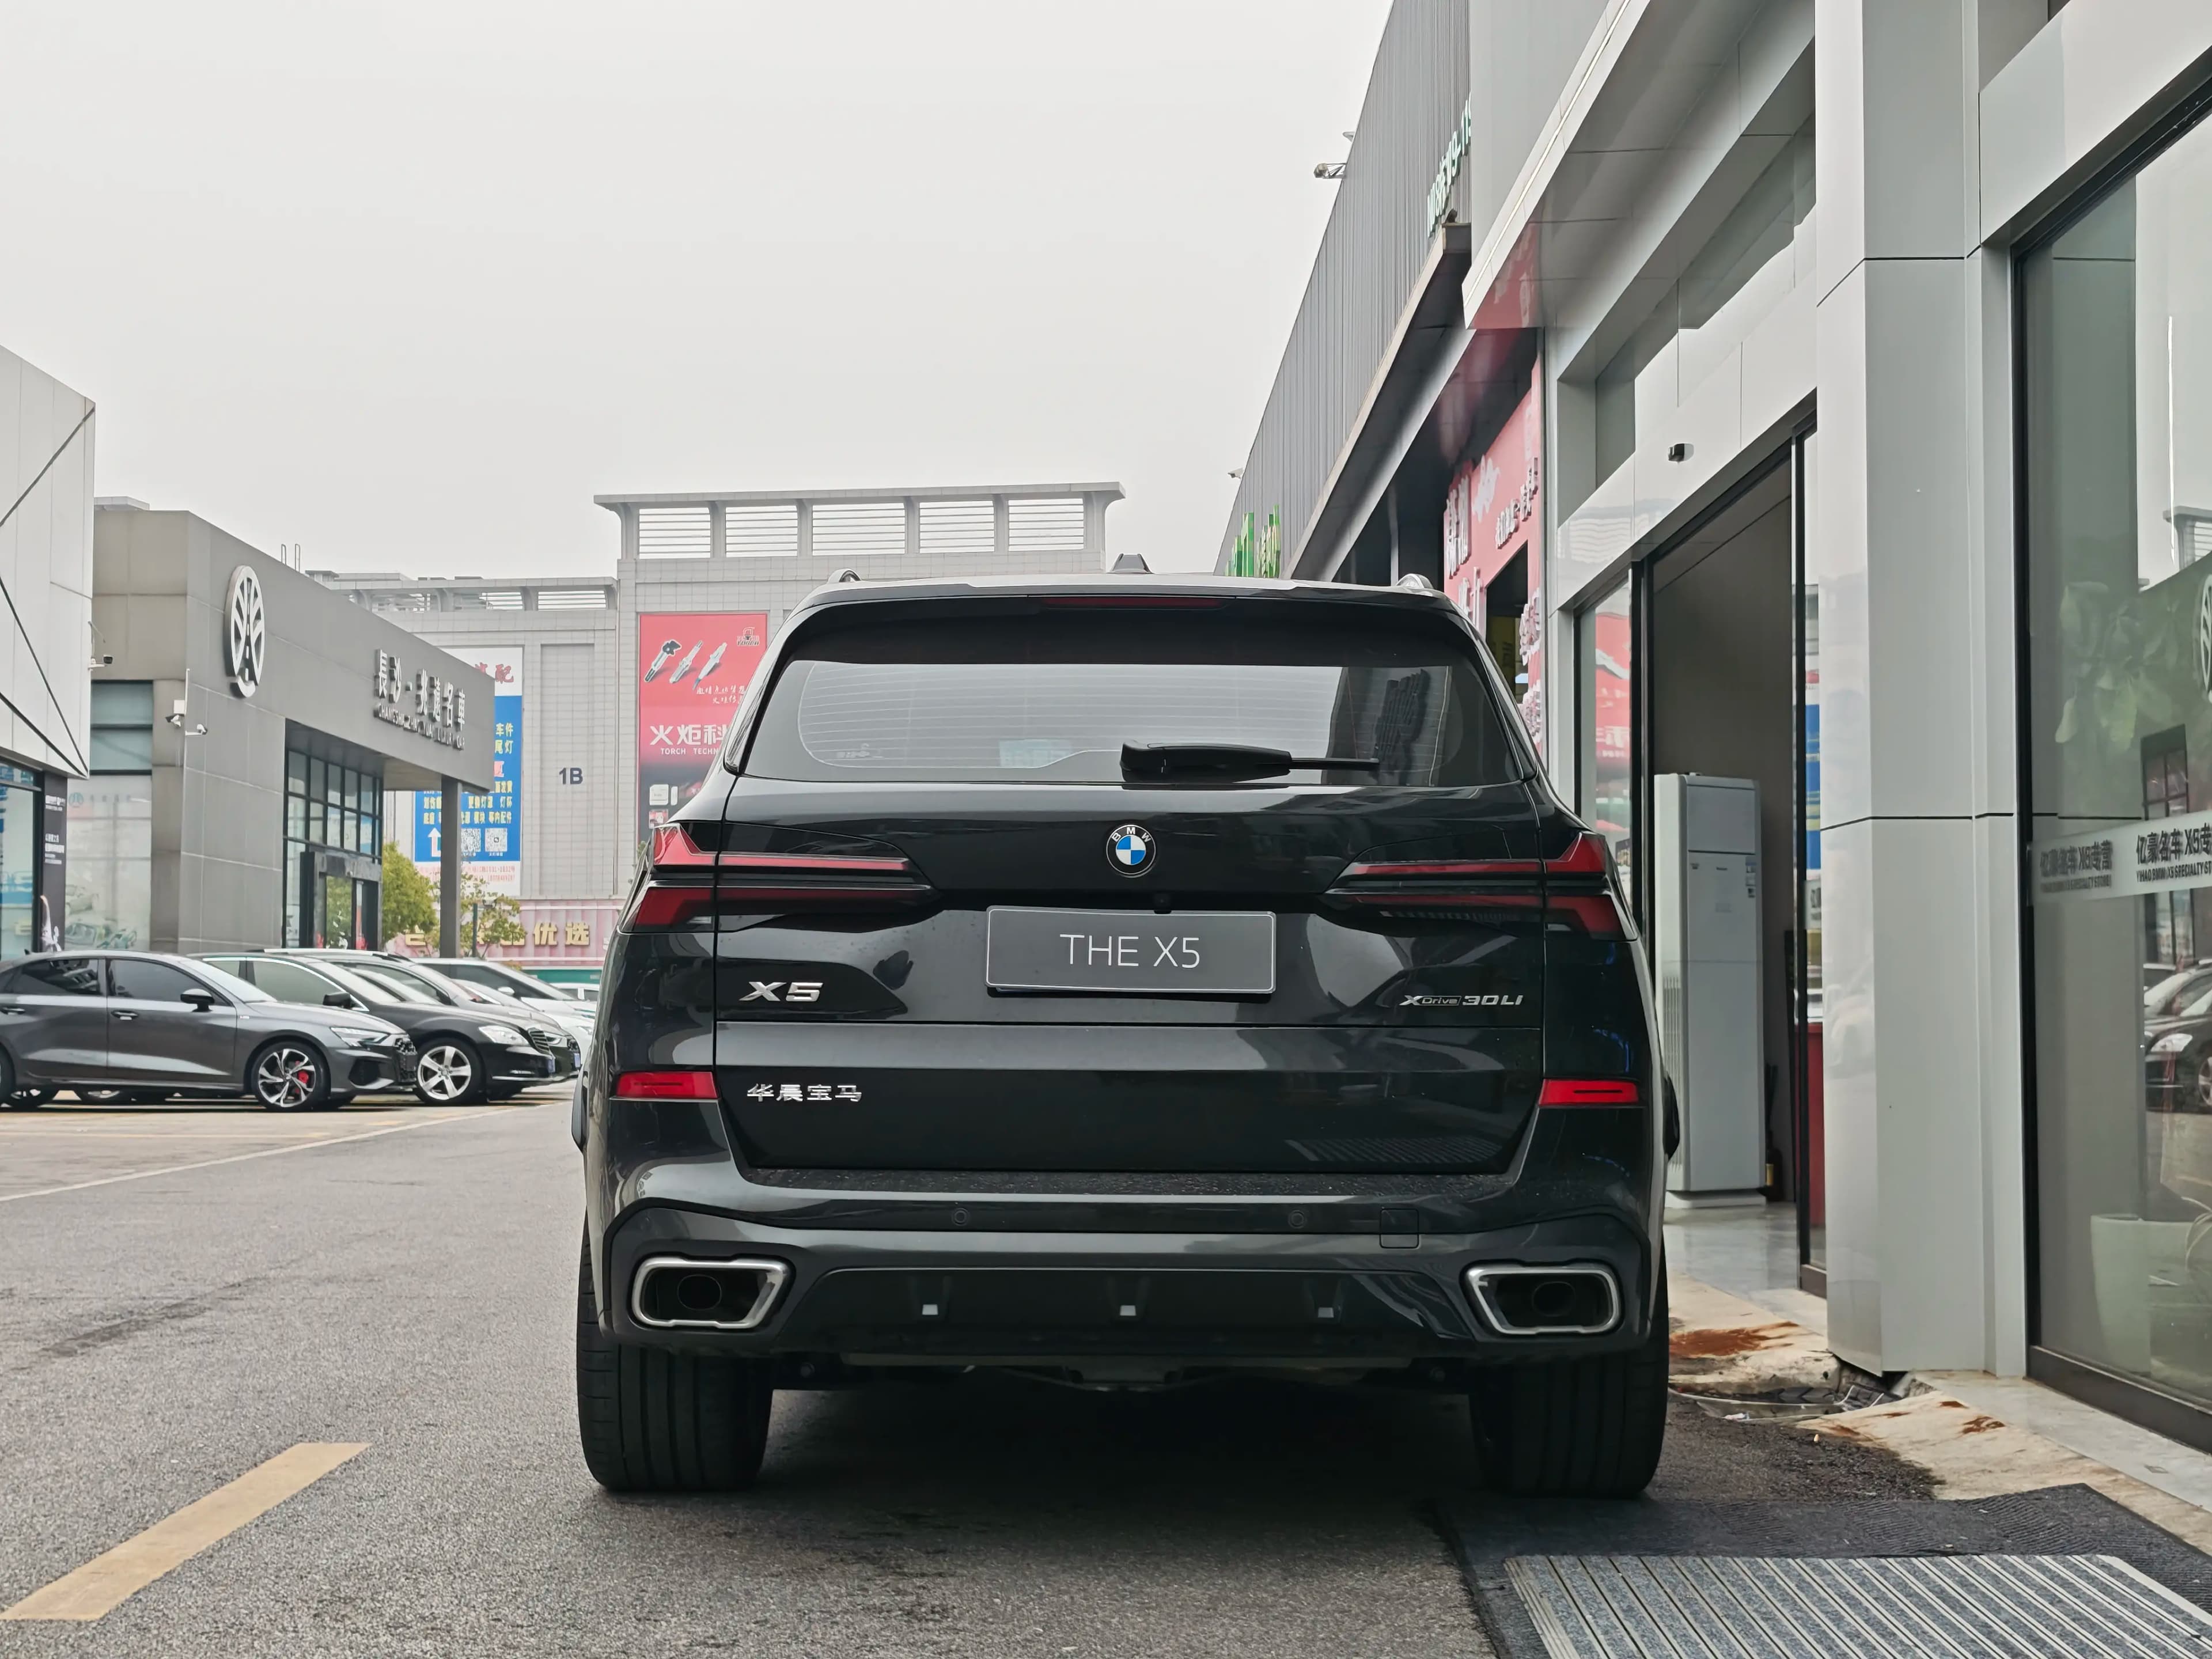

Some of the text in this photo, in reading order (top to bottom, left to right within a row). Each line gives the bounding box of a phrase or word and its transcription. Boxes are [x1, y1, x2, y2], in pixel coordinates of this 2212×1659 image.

[649, 724, 727, 745] 火炬科
[559, 767, 583, 785] 1B
[1111, 827, 1152, 842] BMW
[2135, 827, 2182, 865] 亿豪名车
[1059, 933, 1200, 969] THE X5
[738, 981, 824, 1002] X5
[747, 1083, 862, 1102] 华晨宝马
